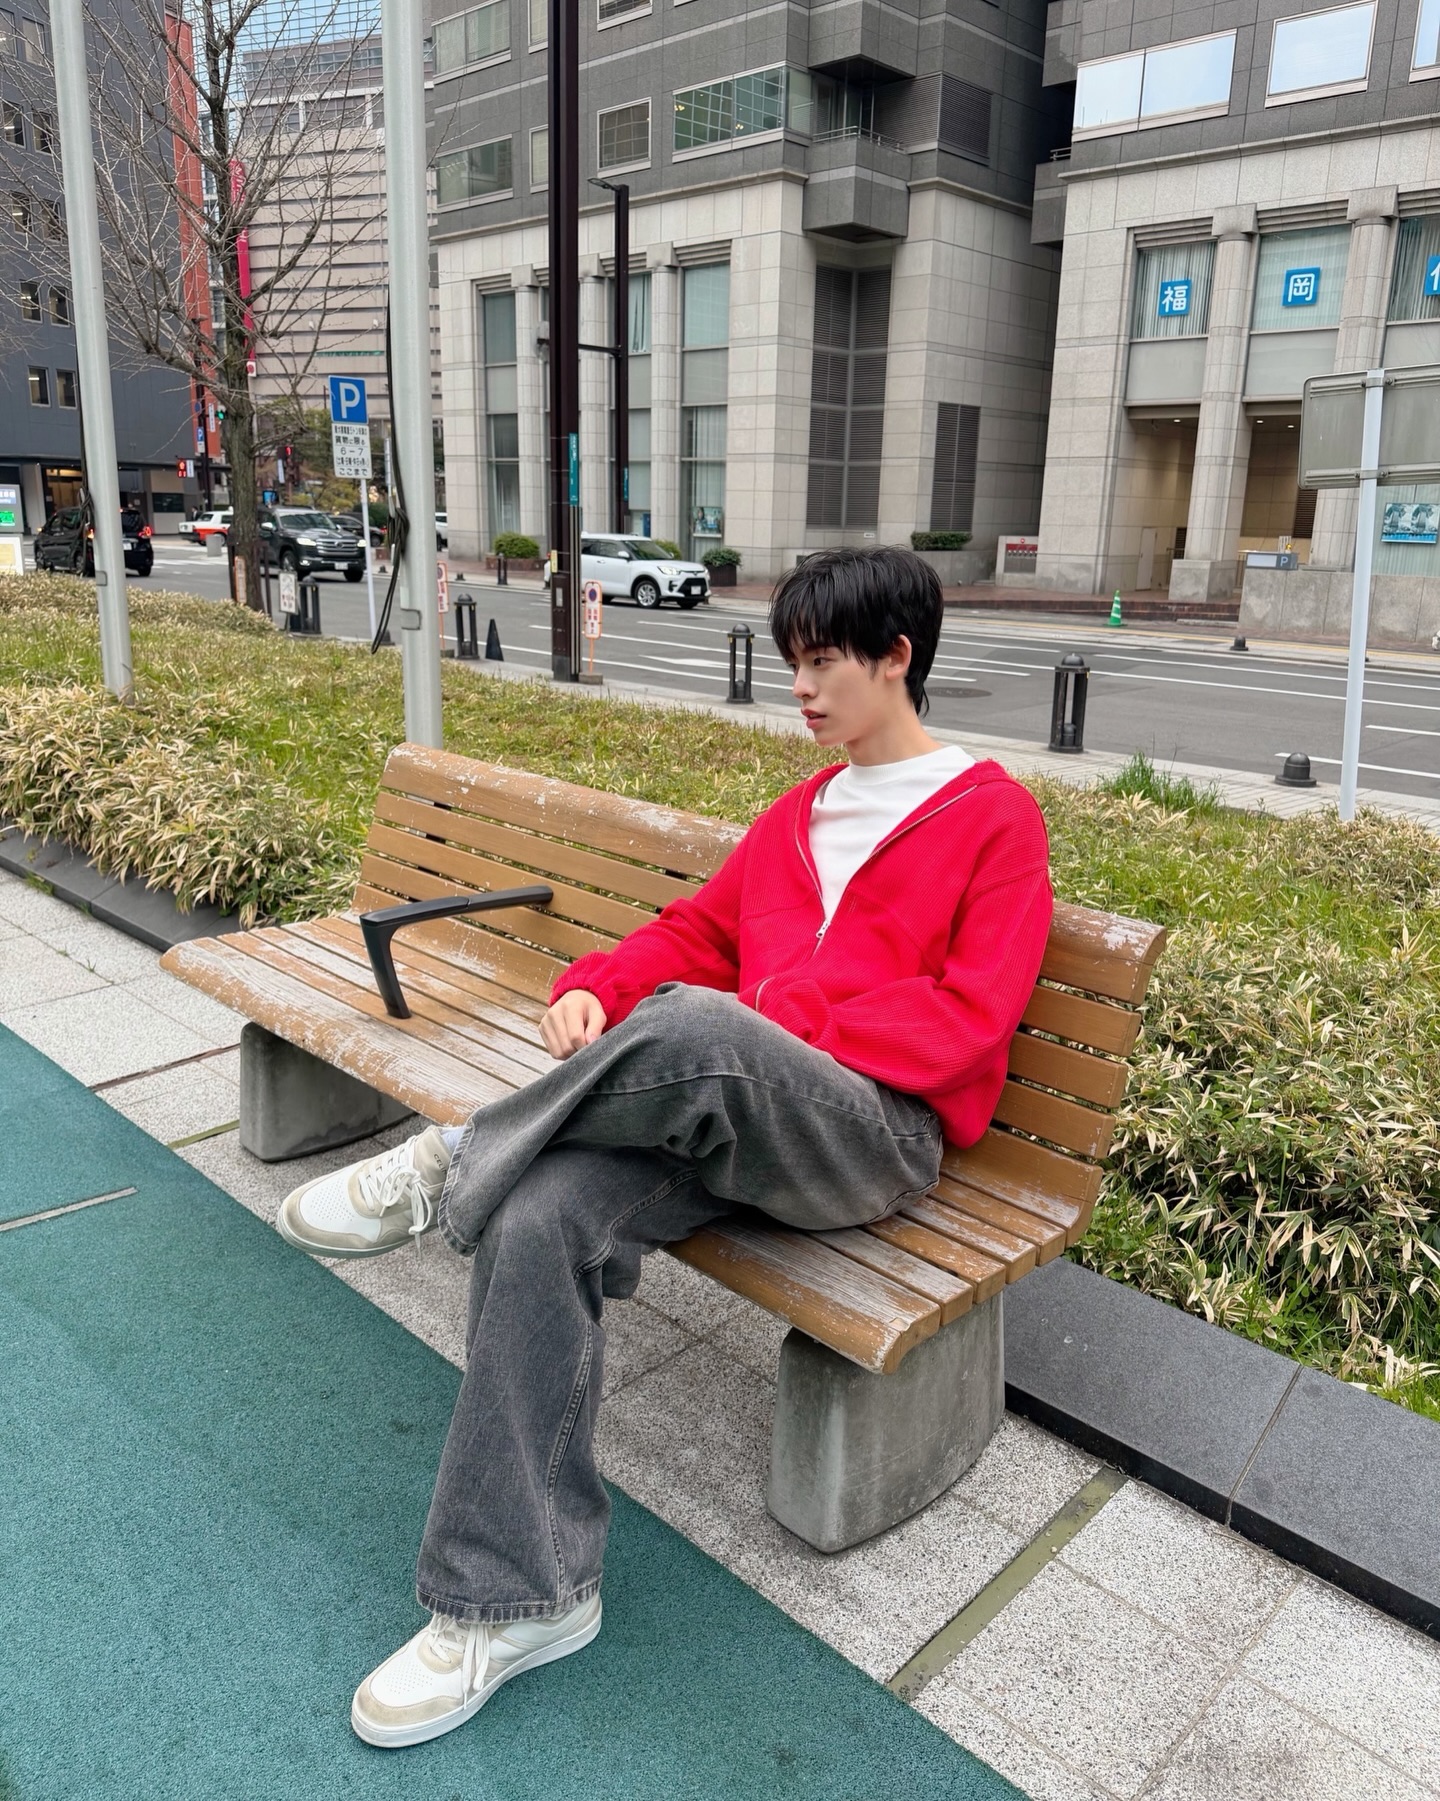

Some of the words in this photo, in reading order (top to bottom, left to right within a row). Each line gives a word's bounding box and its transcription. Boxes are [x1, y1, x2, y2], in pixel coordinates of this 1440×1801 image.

[1162, 285, 1188, 312] 福
[1288, 273, 1315, 302] 岡
[339, 382, 360, 418] P
[339, 468, 367, 476] ここまで
[1280, 556, 1289, 568] P
